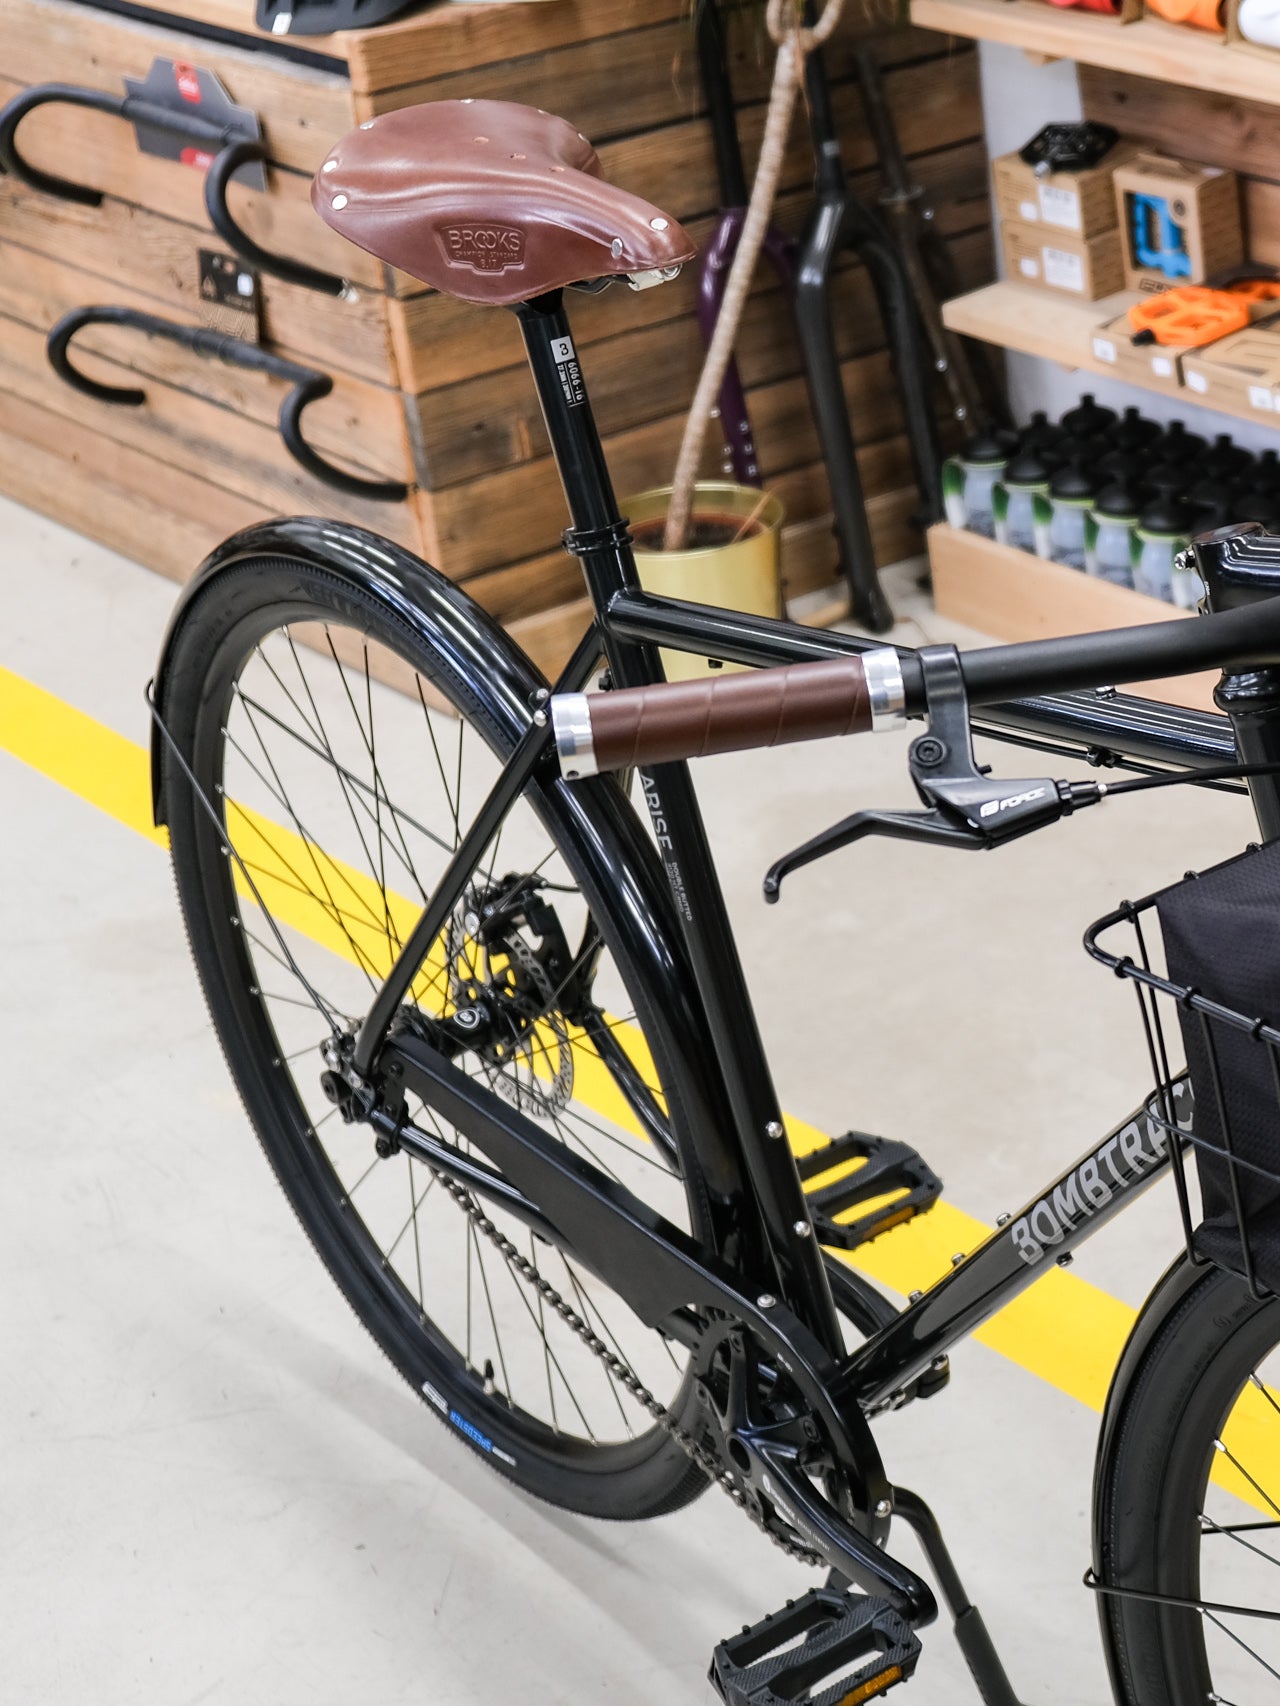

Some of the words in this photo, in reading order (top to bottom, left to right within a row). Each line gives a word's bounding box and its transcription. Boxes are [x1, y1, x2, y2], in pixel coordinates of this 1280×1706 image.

[448, 229, 521, 252] BROOKS
[559, 343, 569, 356] 3
[641, 774, 673, 851] ARISE
[671, 862, 685, 891] DOUBLE
[680, 892, 692, 921] BUTTED
[1011, 1077, 1195, 1266] BOMBTRAC
